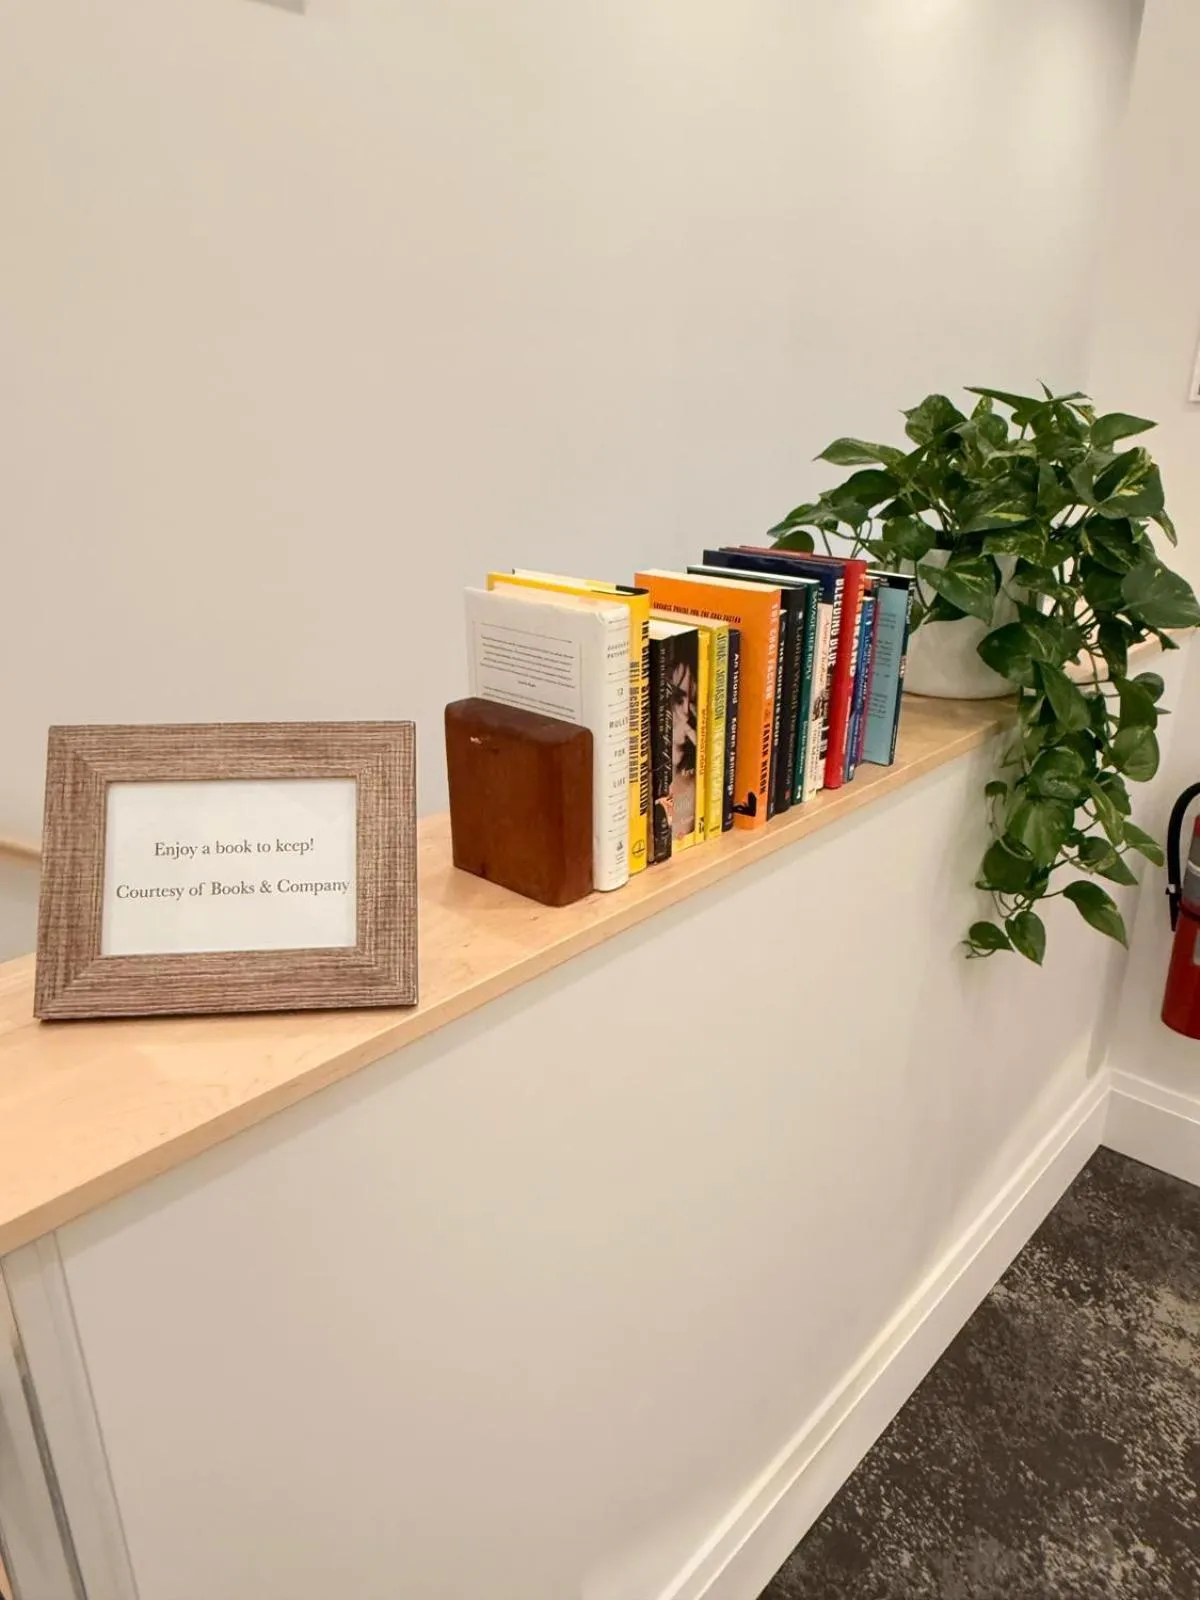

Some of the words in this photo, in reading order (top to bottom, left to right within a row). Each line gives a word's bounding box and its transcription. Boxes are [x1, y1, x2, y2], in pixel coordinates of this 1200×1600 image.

[770, 603, 779, 623] THE
[831, 578, 845, 636] BLEEDING
[641, 620, 649, 641] THE
[768, 626, 777, 656] CHAI
[850, 573, 865, 677] FIREBRAND
[641, 646, 650, 680] GREAT
[733, 653, 740, 668] An
[827, 638, 839, 667] BLUE
[629, 661, 640, 683] NELL
[731, 671, 740, 704] Island
[766, 660, 775, 699] FACTOR
[715, 668, 726, 720] JONASSON
[640, 686, 649, 757] STEWARDESS
[730, 717, 738, 748] Karen
[614, 748, 626, 758] FOR
[762, 723, 771, 757] FARAH
[612, 777, 626, 788] LIFE
[640, 762, 649, 816] REBELLION
[727, 752, 736, 796] Jennings
[760, 760, 768, 796] HERON
[155, 841, 198, 860] Enjoy
[202, 844, 211, 855] a
[216, 839, 252, 855] book
[257, 842, 271, 854] to
[276, 838, 314, 856] keep!
[116, 883, 184, 901] Courtesy
[189, 882, 206, 897] of
[211, 880, 255, 896] Books
[259, 879, 272, 894] &
[277, 878, 350, 897] Company
